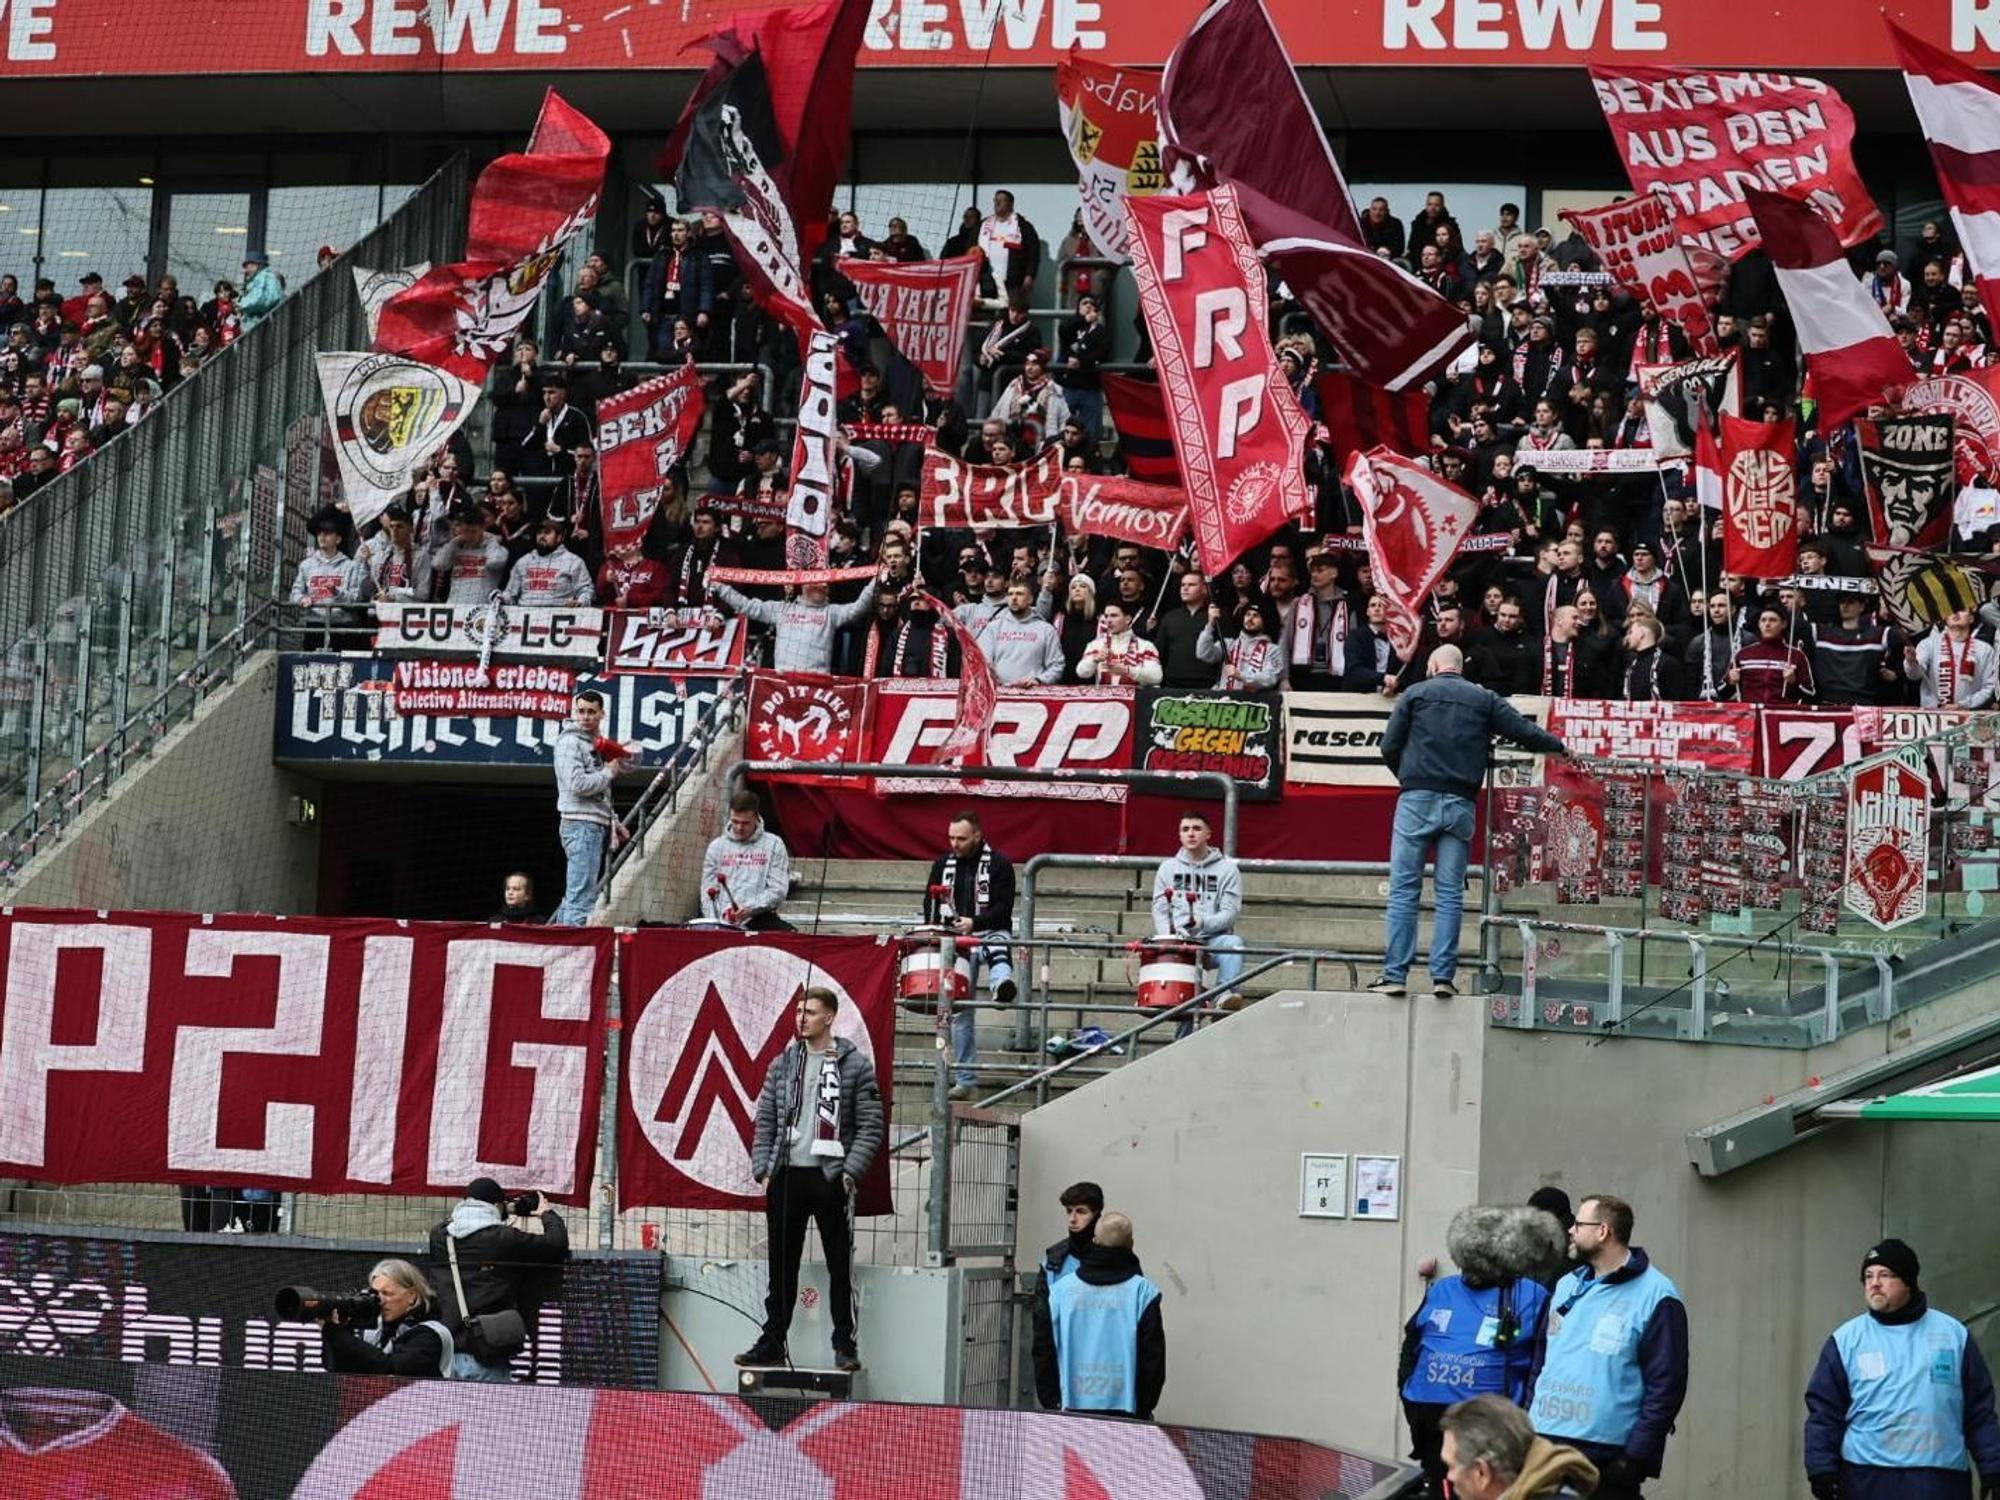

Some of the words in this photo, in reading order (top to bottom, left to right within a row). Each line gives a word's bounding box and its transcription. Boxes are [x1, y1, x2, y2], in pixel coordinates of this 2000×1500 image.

[306, 0, 567, 56] REWE
[1382, 0, 1667, 51] REWE
[1628, 126, 1717, 168] AUS
[1724, 101, 1827, 153] DEN
[1883, 425, 1948, 452] ZONE
[1061, 477, 1188, 543] Vamos!
[399, 661, 490, 690] Visione
[496, 664, 569, 692] erleben
[787, 685, 810, 699] IT
[399, 690, 454, 709] Colectivo
[1154, 699, 1268, 732] RASENBALL
[1175, 726, 1247, 754] GEGEN
[1427, 1360, 1476, 1388] S234
